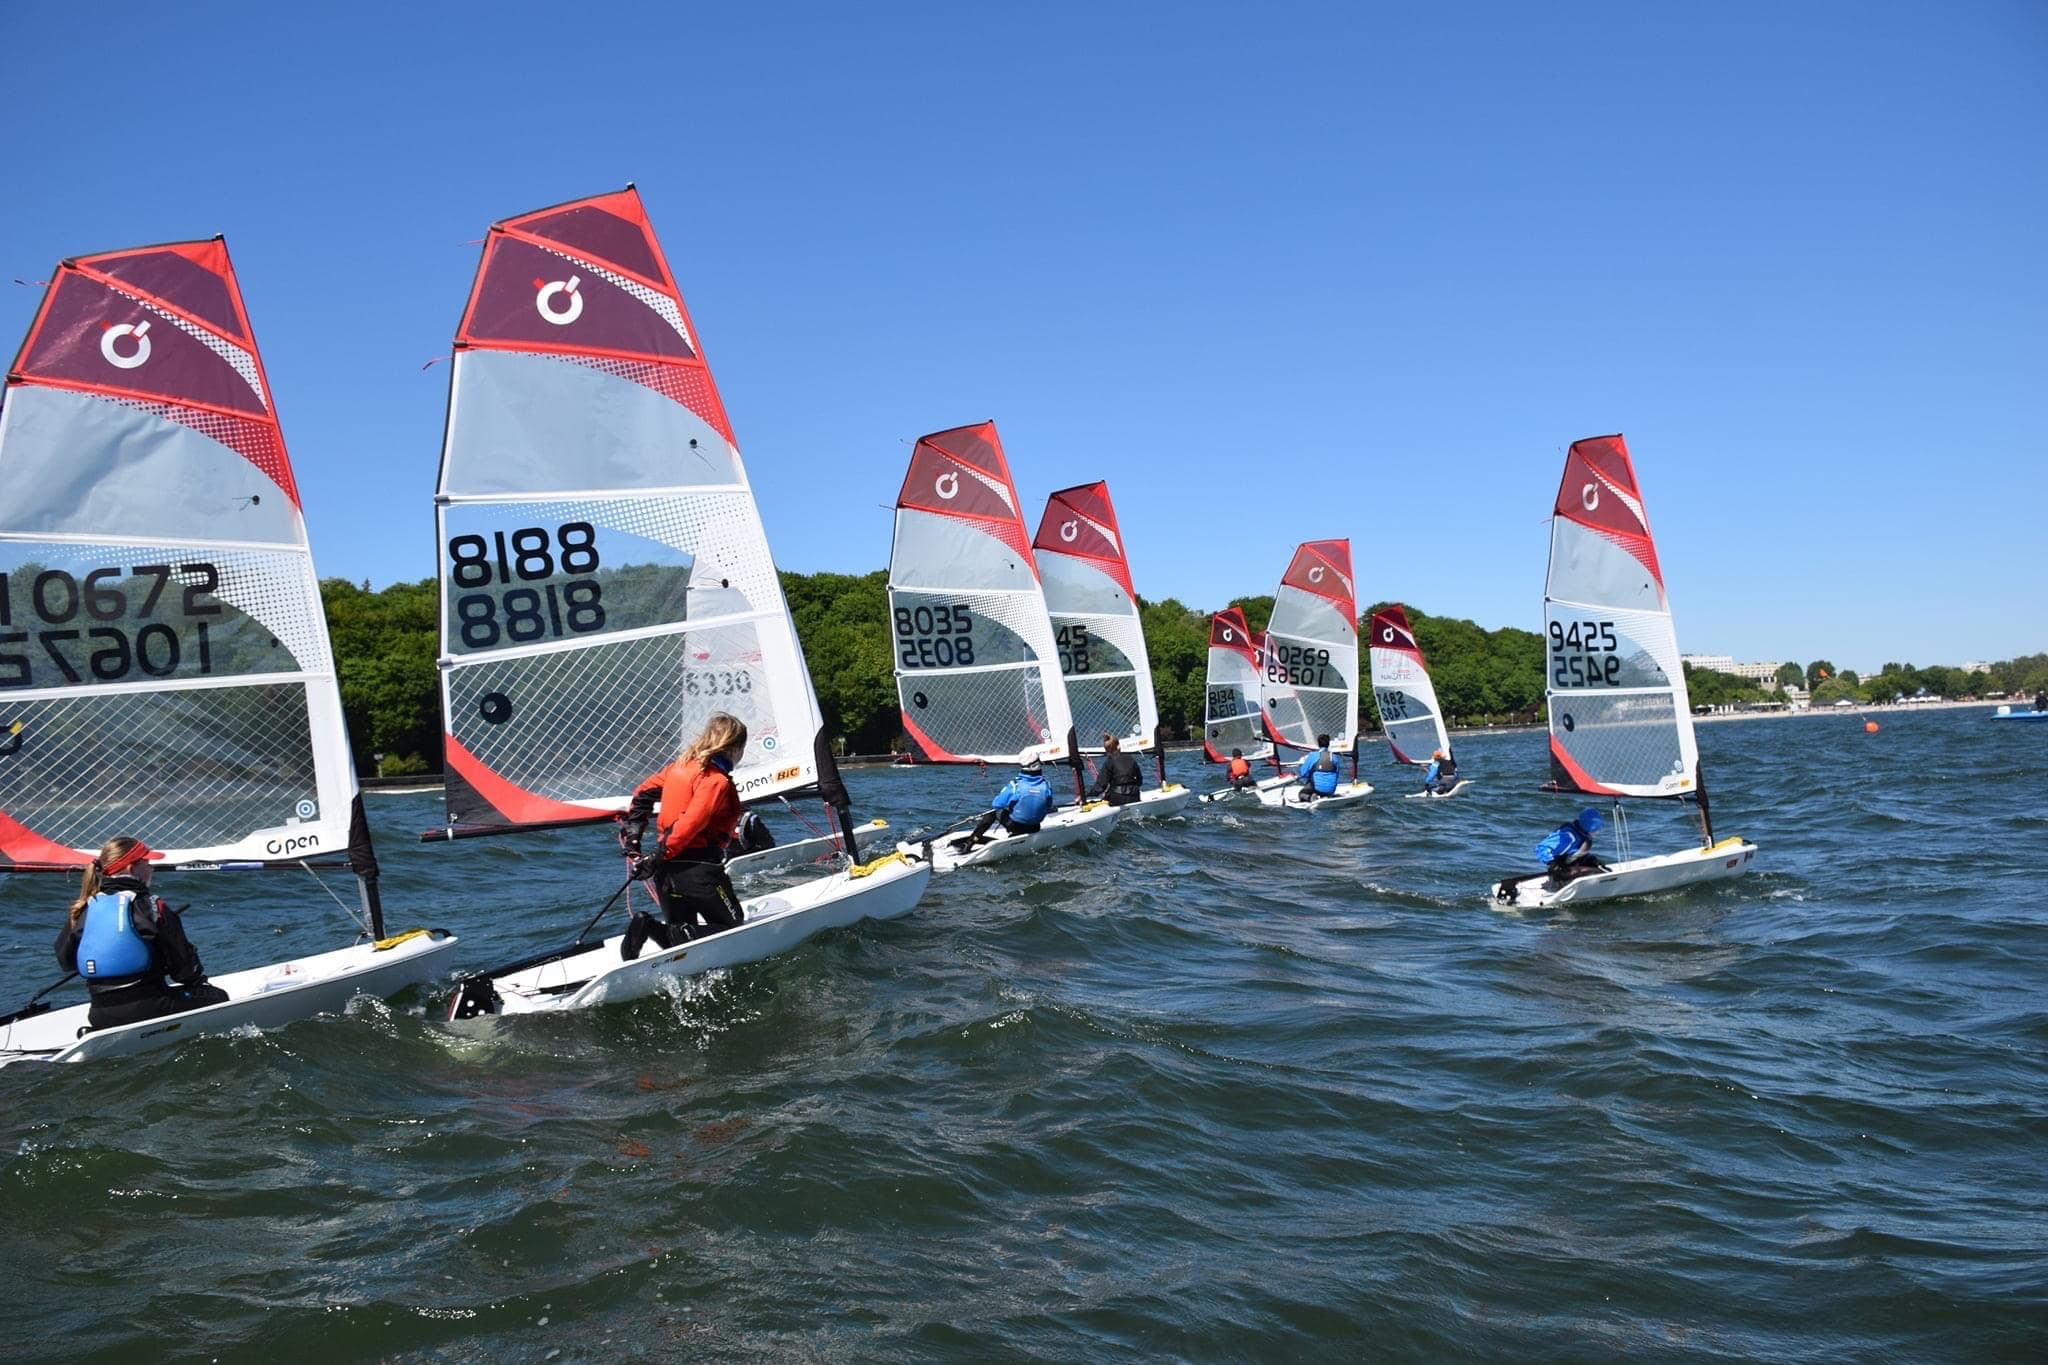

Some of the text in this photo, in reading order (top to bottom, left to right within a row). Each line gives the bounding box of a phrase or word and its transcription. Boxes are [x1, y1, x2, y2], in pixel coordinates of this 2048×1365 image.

[448, 521, 600, 589] 8188
[0, 562, 222, 626] 10672
[894, 605, 973, 636] 8035
[1056, 625, 1089, 649] 45
[1549, 620, 1618, 653] 9425
[1270, 645, 1330, 667] 10269
[1208, 689, 1235, 705] 8134
